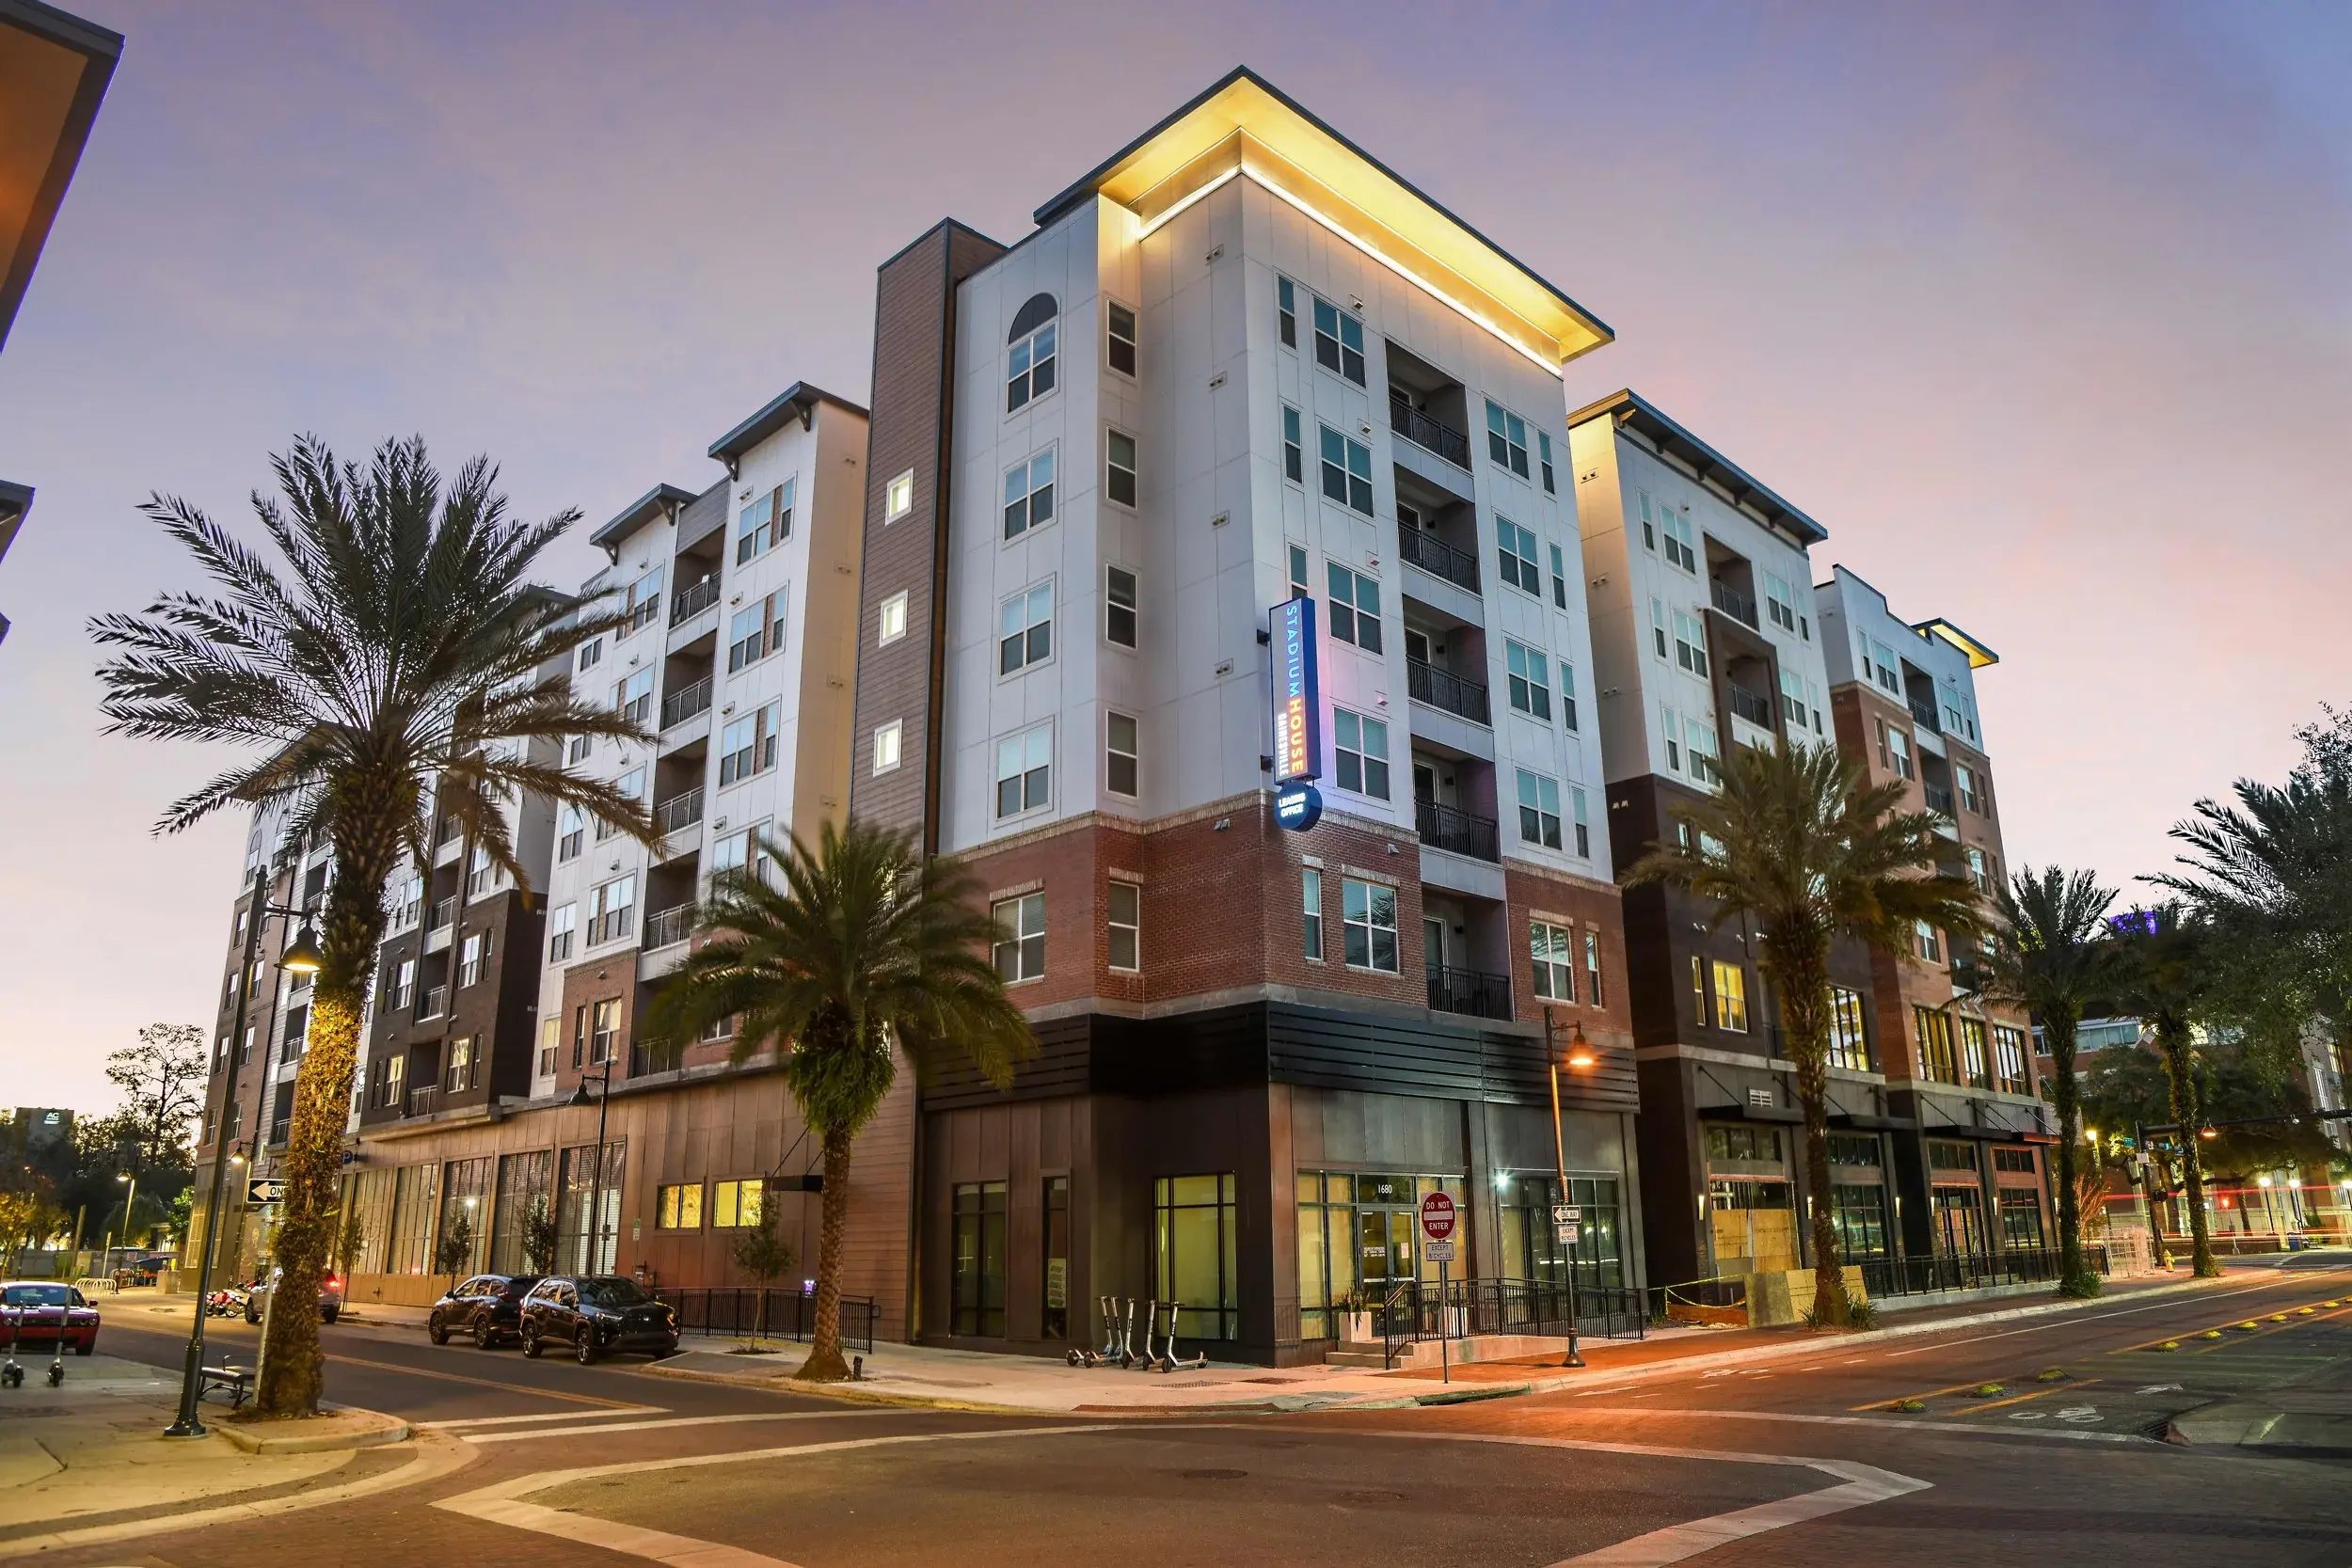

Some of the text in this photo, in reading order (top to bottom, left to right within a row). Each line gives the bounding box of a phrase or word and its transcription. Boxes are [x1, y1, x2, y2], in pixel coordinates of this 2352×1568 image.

[1377, 1184, 1392, 1194] 1680
[1425, 1200, 1450, 1210] DO NOT
[1429, 1222, 1449, 1230] ENTER
